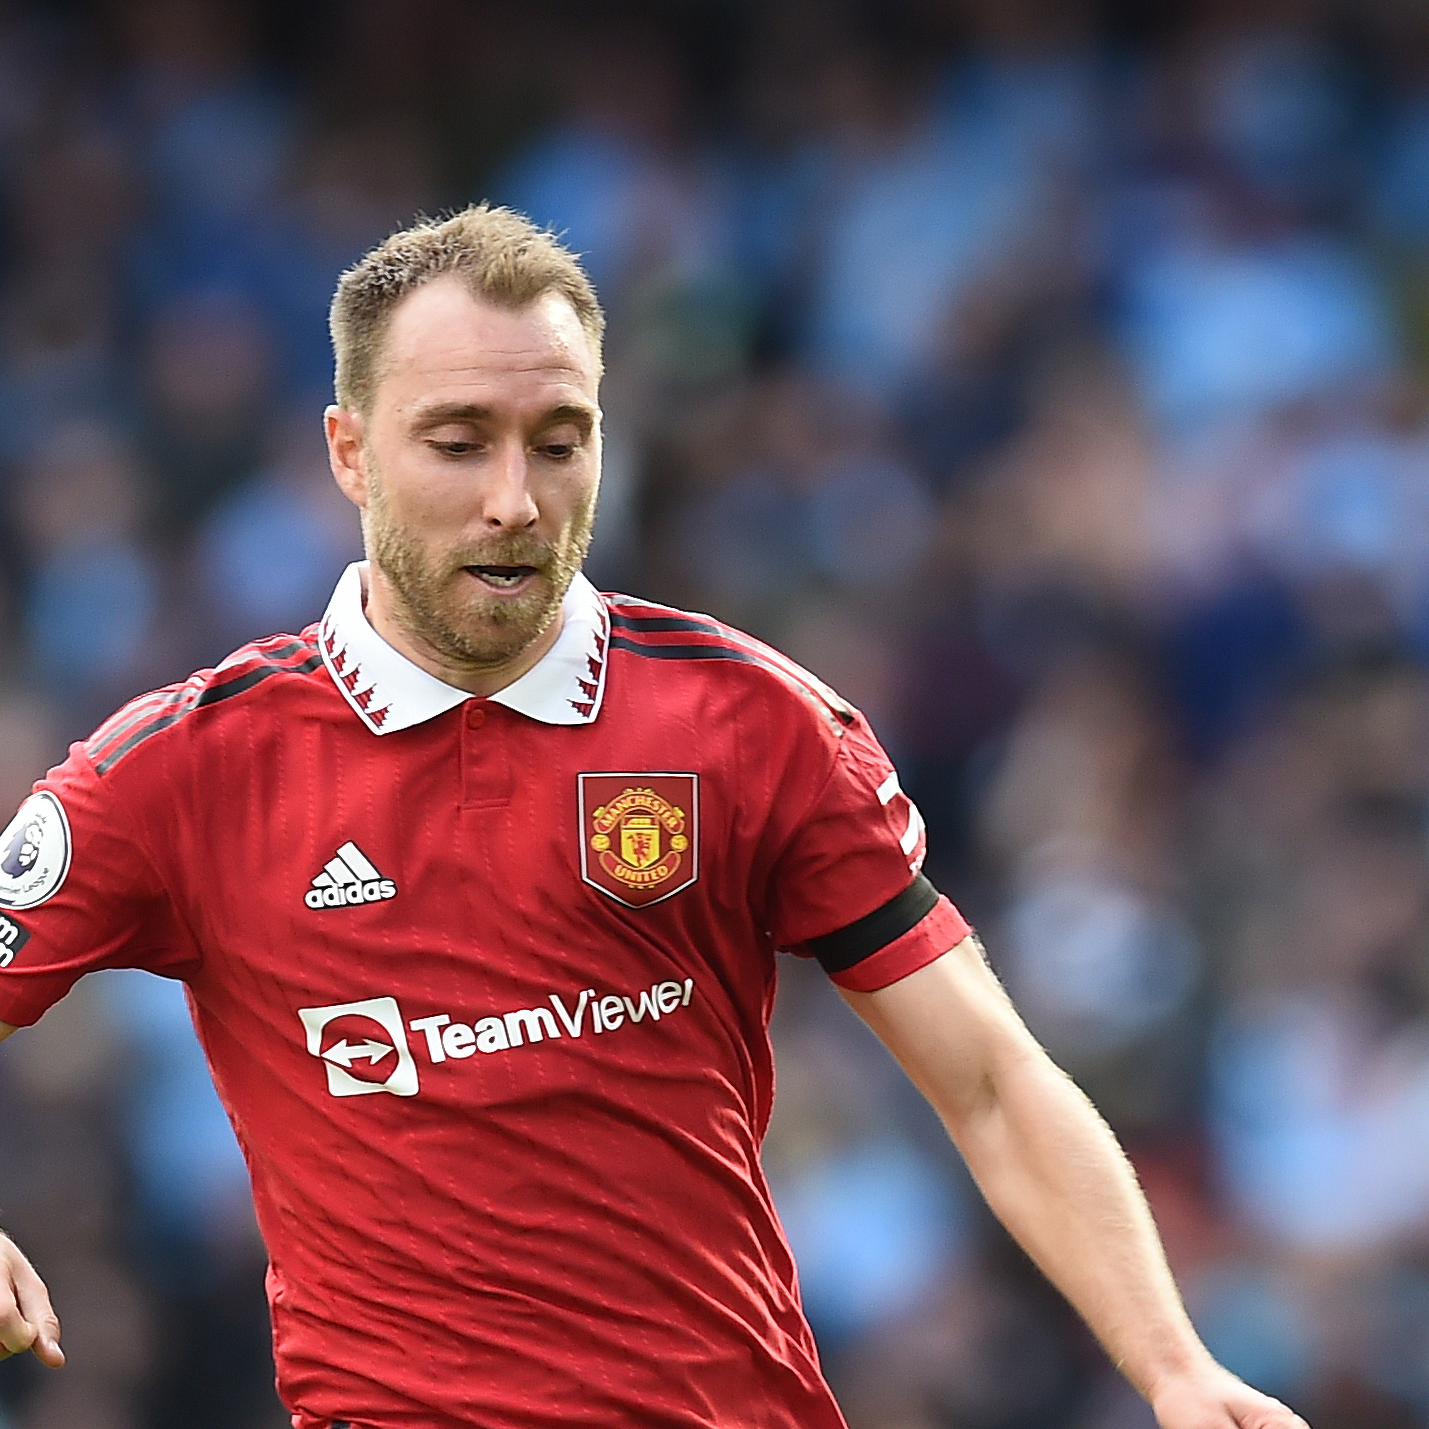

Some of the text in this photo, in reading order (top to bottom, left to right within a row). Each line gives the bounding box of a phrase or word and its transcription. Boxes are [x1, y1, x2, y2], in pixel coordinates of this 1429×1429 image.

[599, 795, 678, 828] MANCHESTER
[614, 864, 669, 882] UNITED
[304, 879, 397, 909] adidas
[409, 978, 694, 1063] TeamViewer
